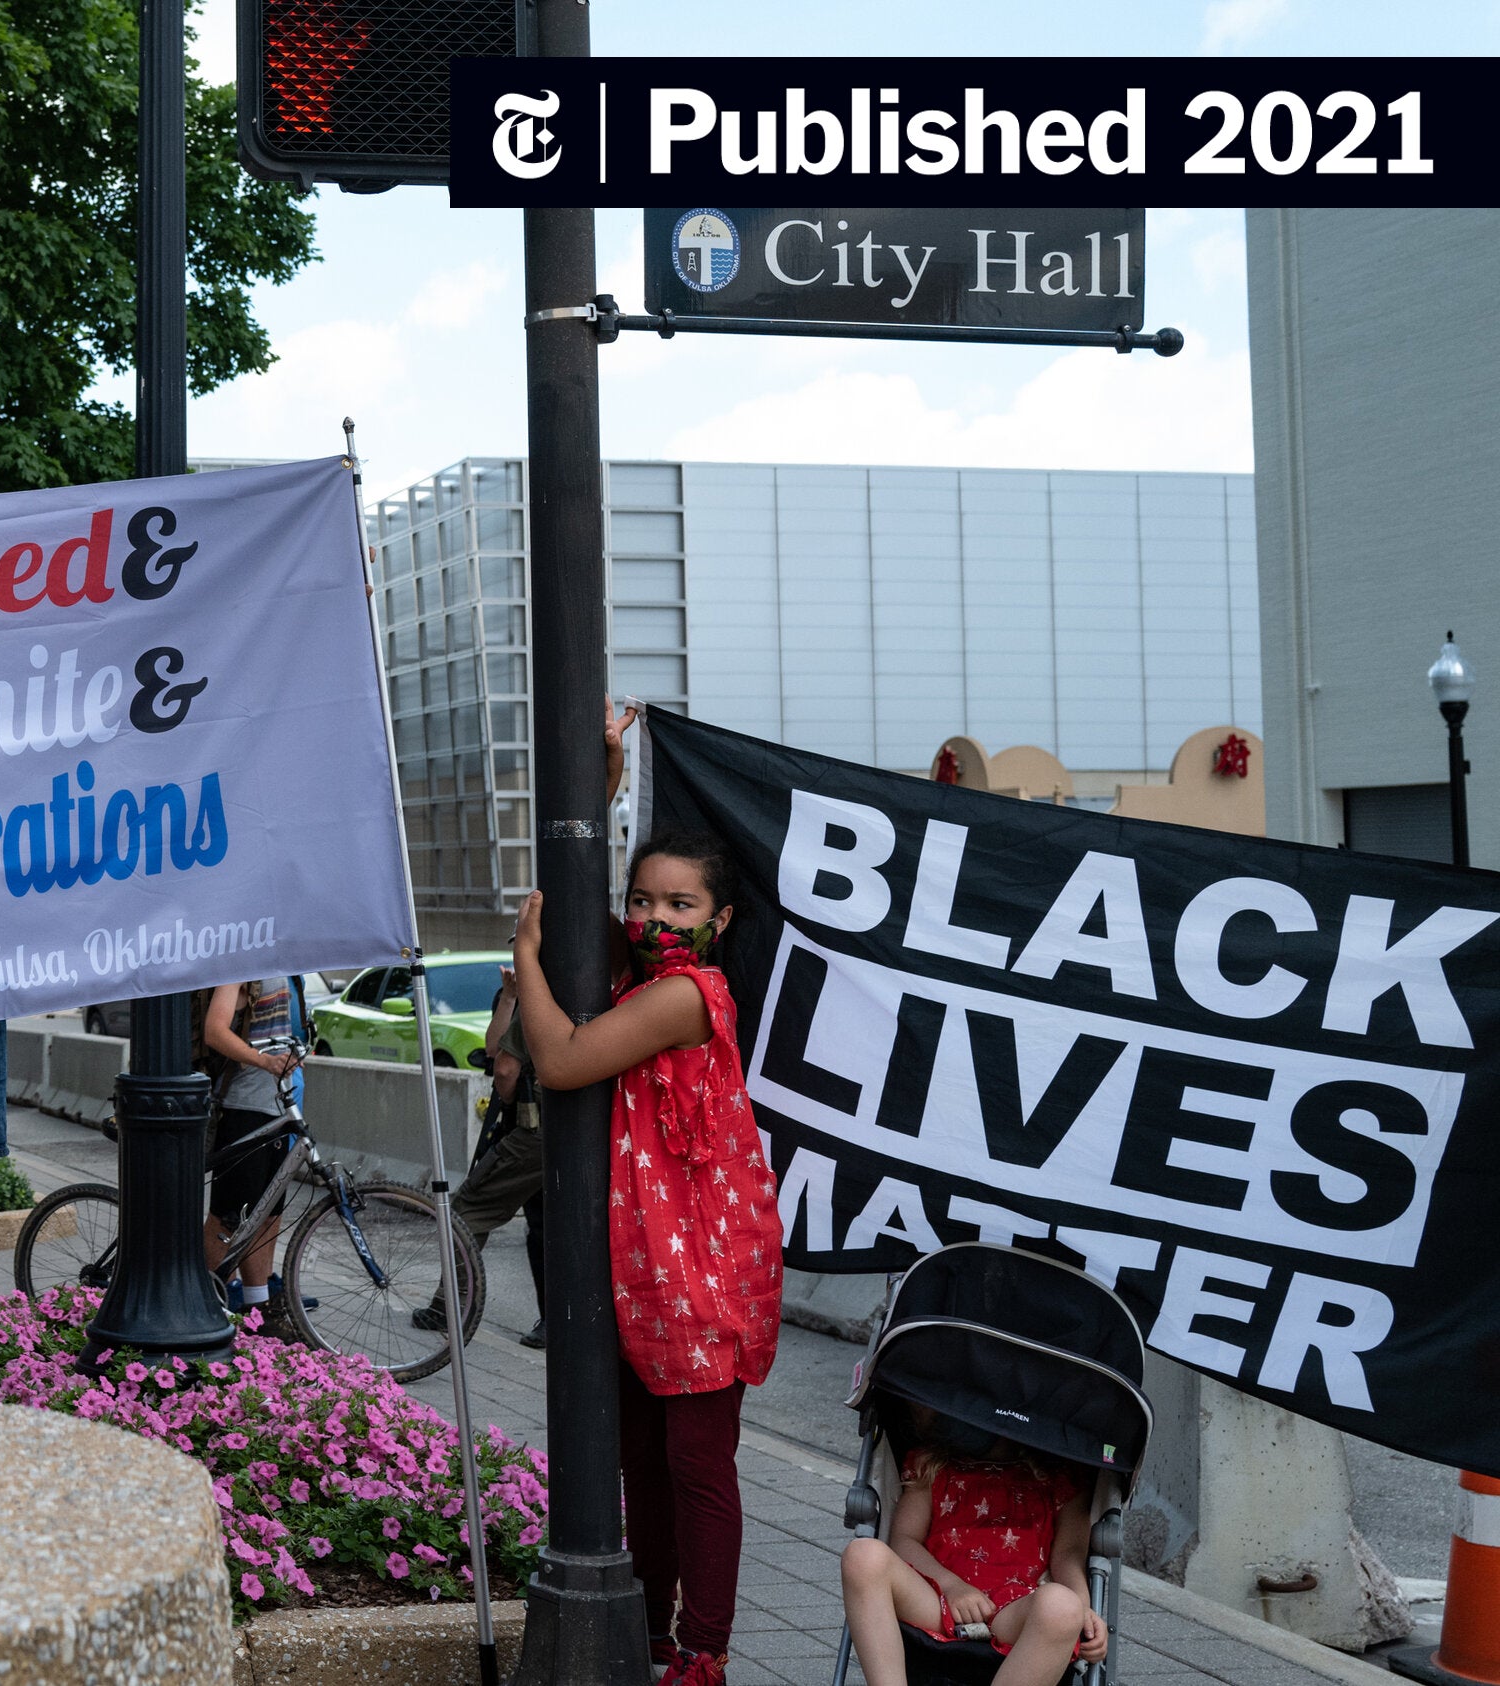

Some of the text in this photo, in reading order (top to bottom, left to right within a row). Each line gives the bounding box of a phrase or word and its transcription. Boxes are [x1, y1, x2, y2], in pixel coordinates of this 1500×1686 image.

[672, 251, 740, 292] CITY OF TULSA OKLAHOMA
[764, 219, 1135, 308] City Hall
[83, 916, 276, 975] Oklahoma
[778, 788, 1500, 1050] BLACK
[760, 944, 1430, 1232] LIVES
